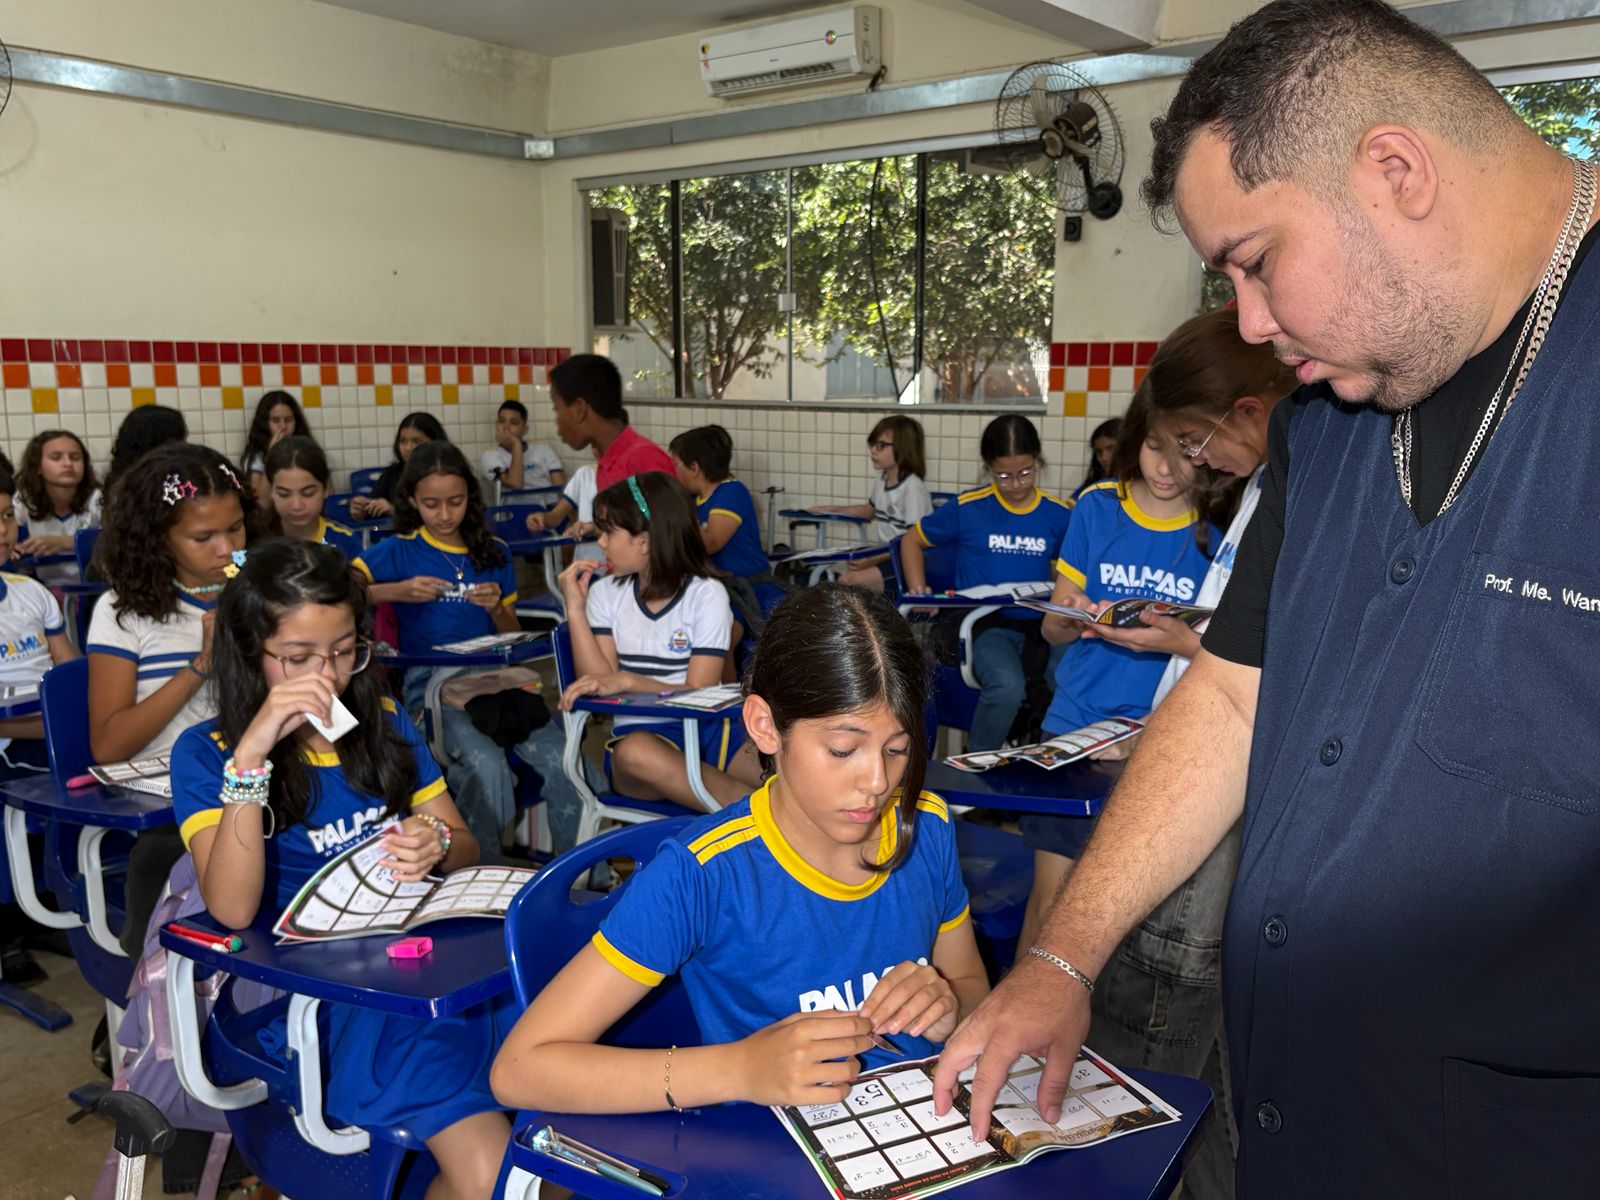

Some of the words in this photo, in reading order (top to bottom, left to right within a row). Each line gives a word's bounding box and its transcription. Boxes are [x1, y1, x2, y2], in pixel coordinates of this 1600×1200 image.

[989, 534, 1046, 552] PALMAS
[1100, 563, 1195, 601] PALMAS
[1484, 573, 1513, 594] Prof.
[0, 632, 46, 658] PALMA
[307, 805, 399, 854] PALM
[799, 957, 928, 1013] PALM
